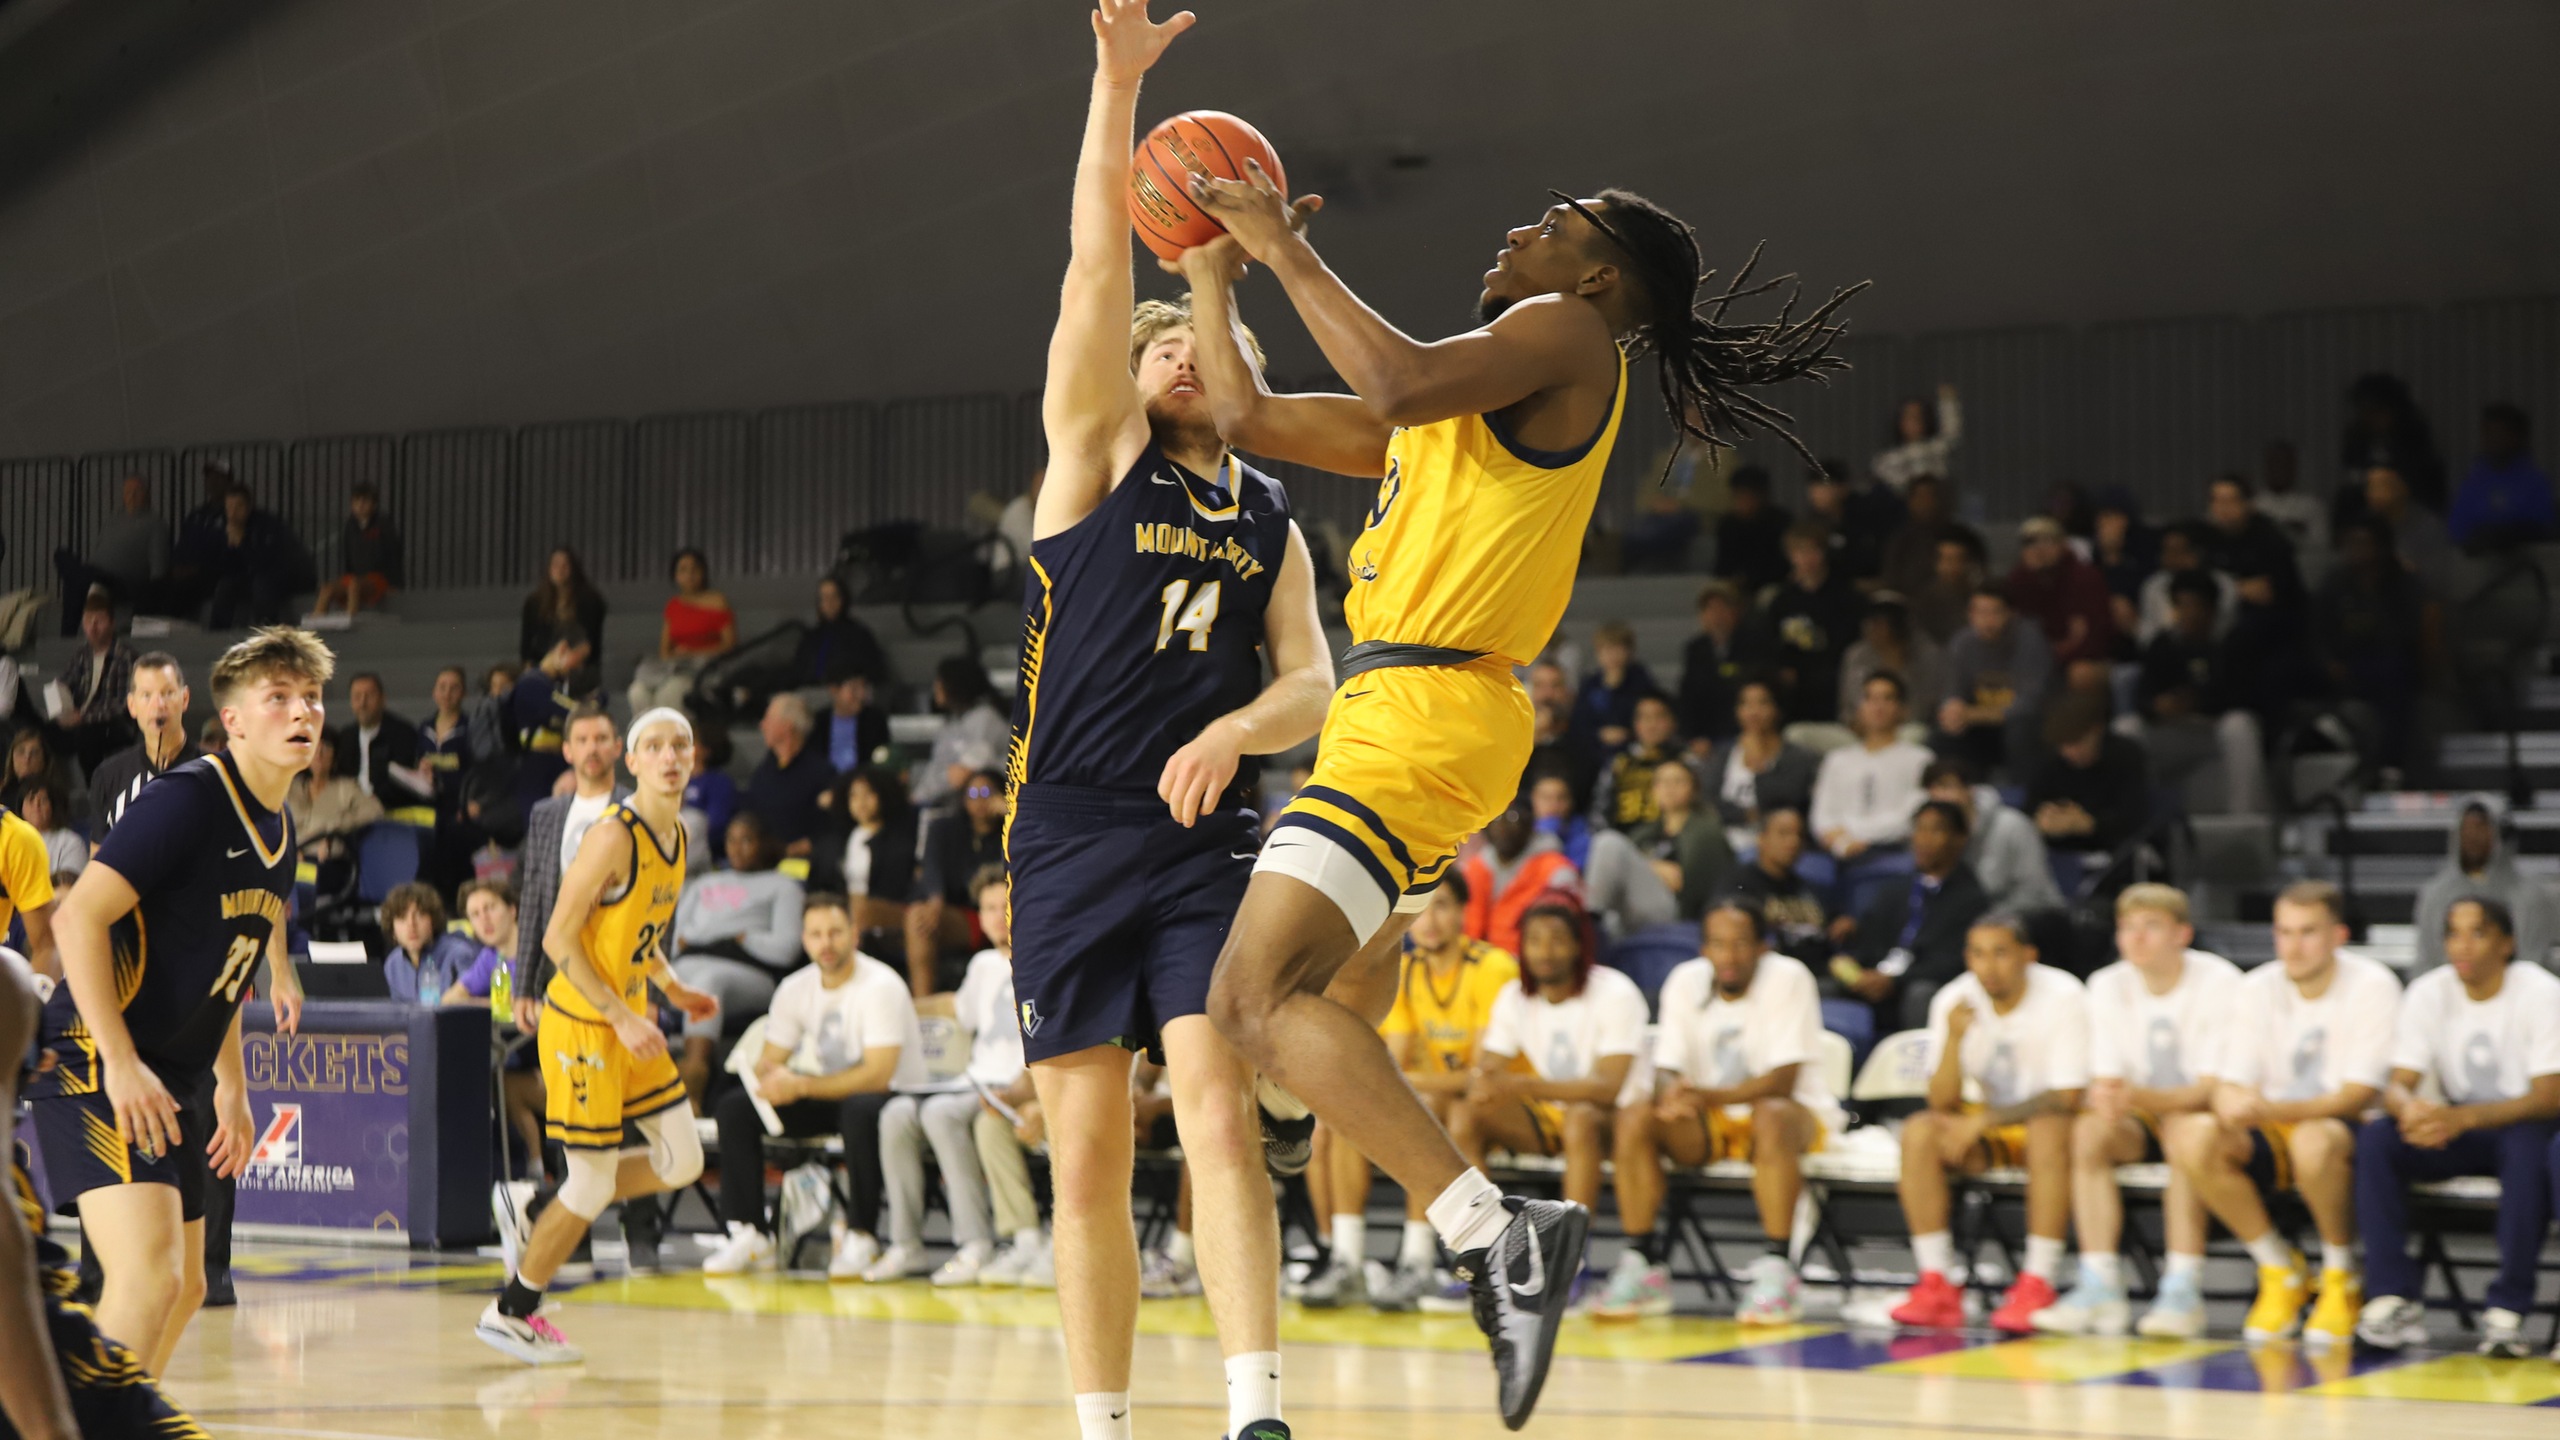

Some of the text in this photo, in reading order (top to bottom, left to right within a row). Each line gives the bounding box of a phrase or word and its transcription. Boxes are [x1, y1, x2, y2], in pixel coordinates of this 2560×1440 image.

[1135, 522, 1209, 562] MOUNT
[1154, 578, 1221, 654] 14
[242, 1031, 408, 1095] CKETS
